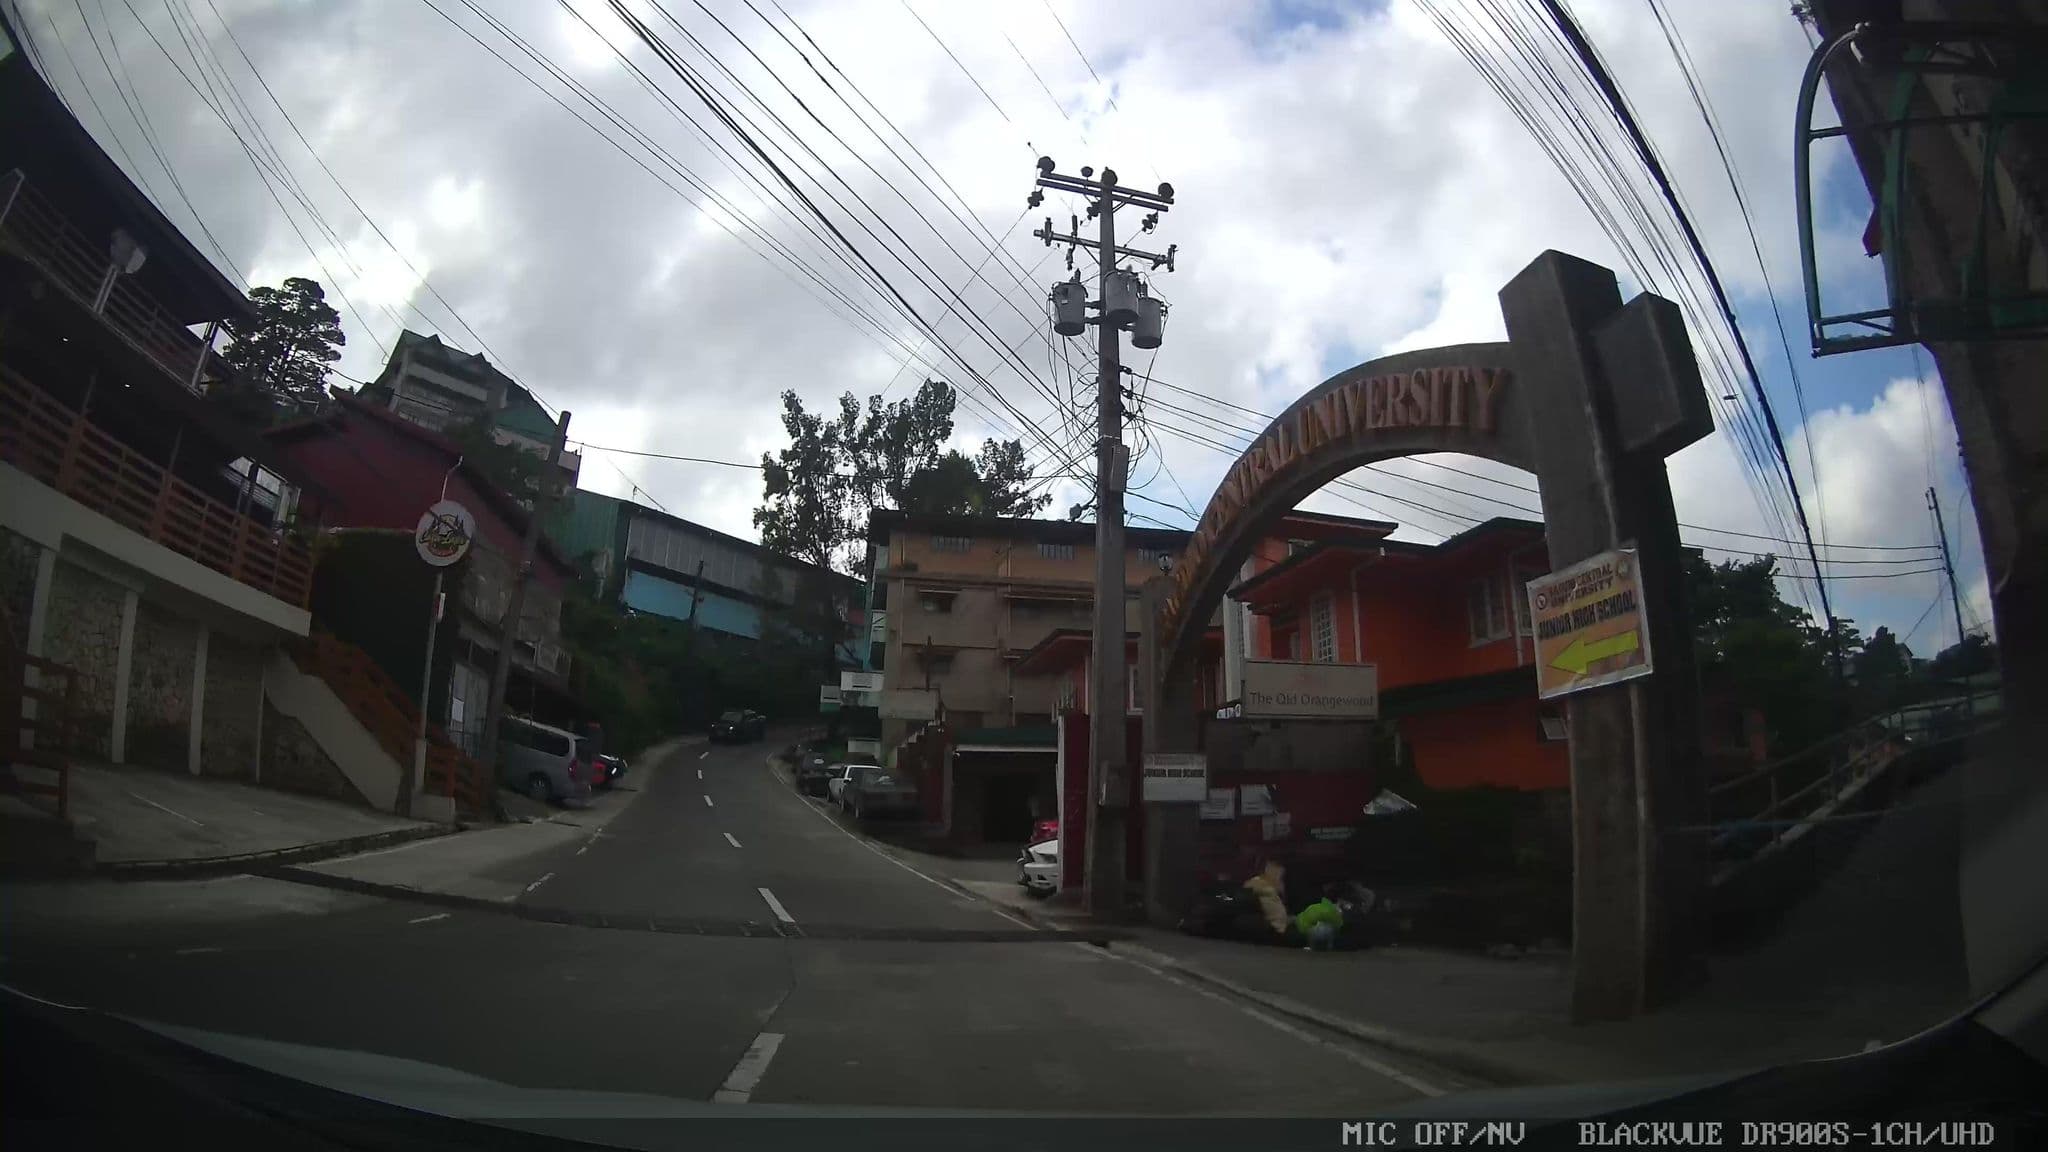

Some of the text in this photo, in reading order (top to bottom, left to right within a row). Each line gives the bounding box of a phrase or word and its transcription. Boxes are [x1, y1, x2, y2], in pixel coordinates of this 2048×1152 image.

[1298, 365, 1511, 447] UNIVERSITY
[1539, 589, 1636, 640] JUNIOR HIGH SCHOOL
[1250, 691, 1272, 705] The
[1301, 694, 1374, 709] Orangewood
